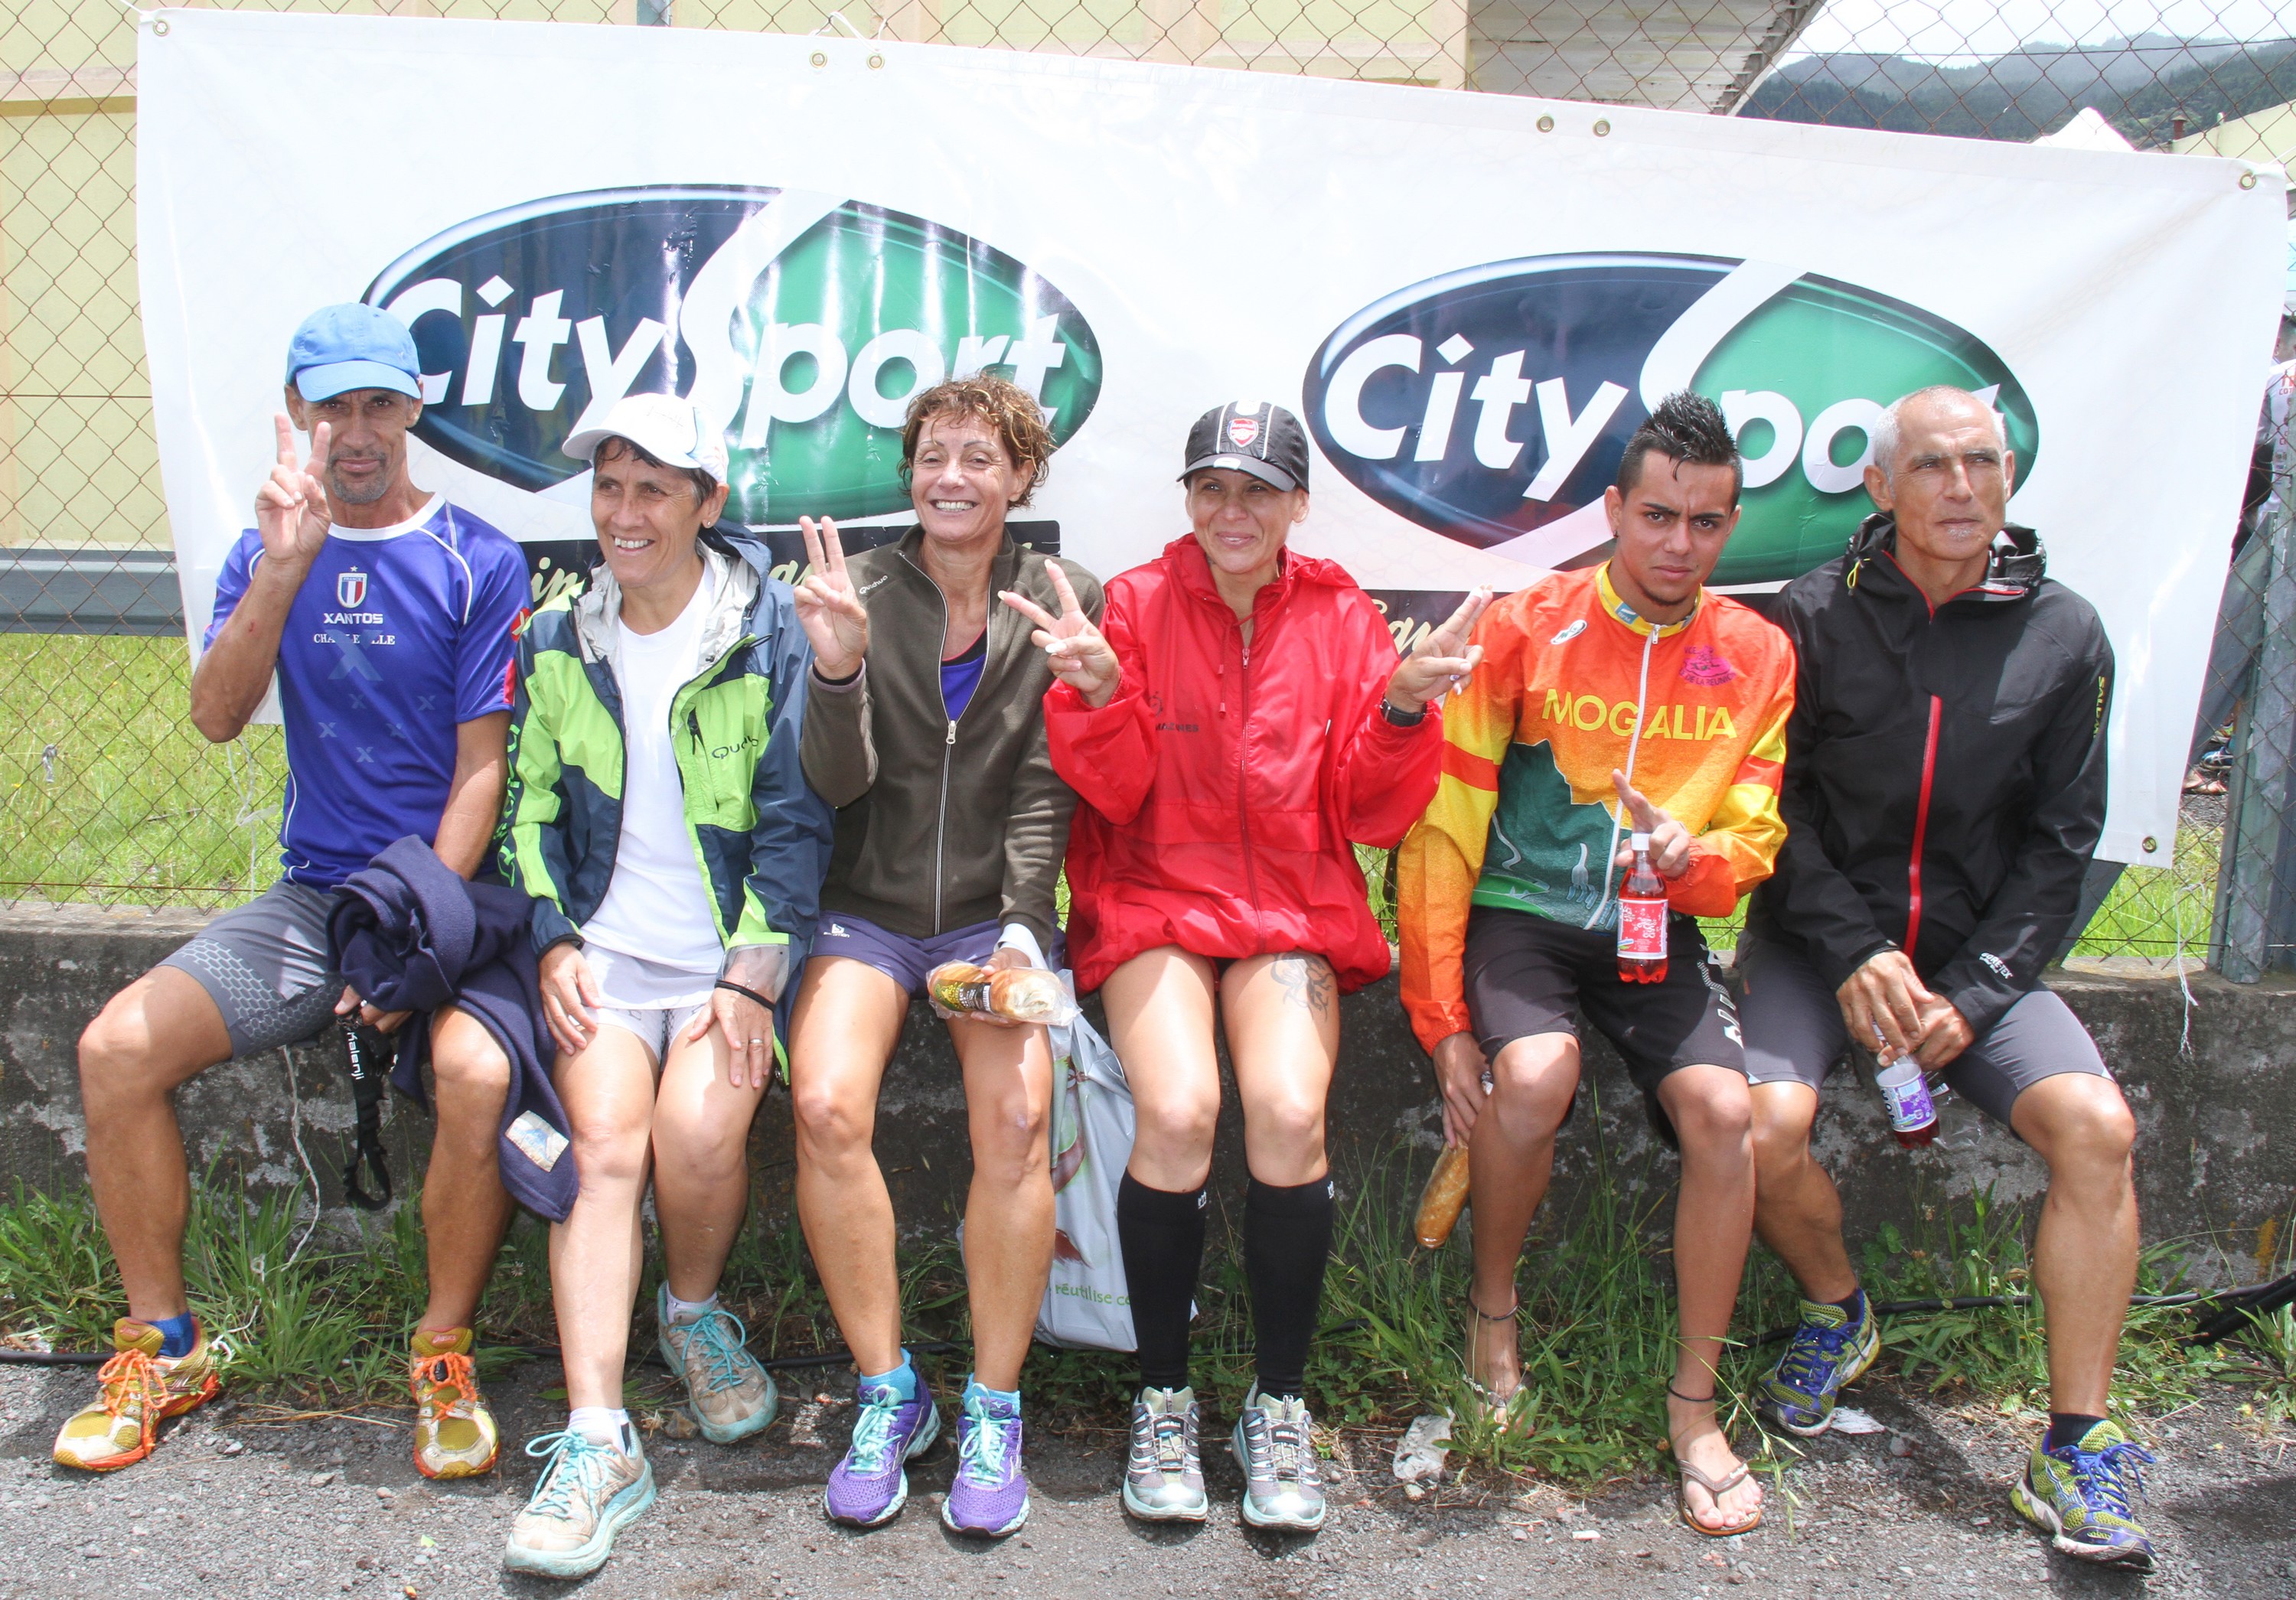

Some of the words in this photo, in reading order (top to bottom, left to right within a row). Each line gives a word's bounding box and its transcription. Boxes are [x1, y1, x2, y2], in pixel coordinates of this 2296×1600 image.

[383, 275, 668, 436] City
[1325, 333, 1629, 503] City
[323, 612, 384, 625] XANTOS
[1542, 689, 1737, 741] MOGALIA
[1055, 1282, 1113, 1305] réutilise
